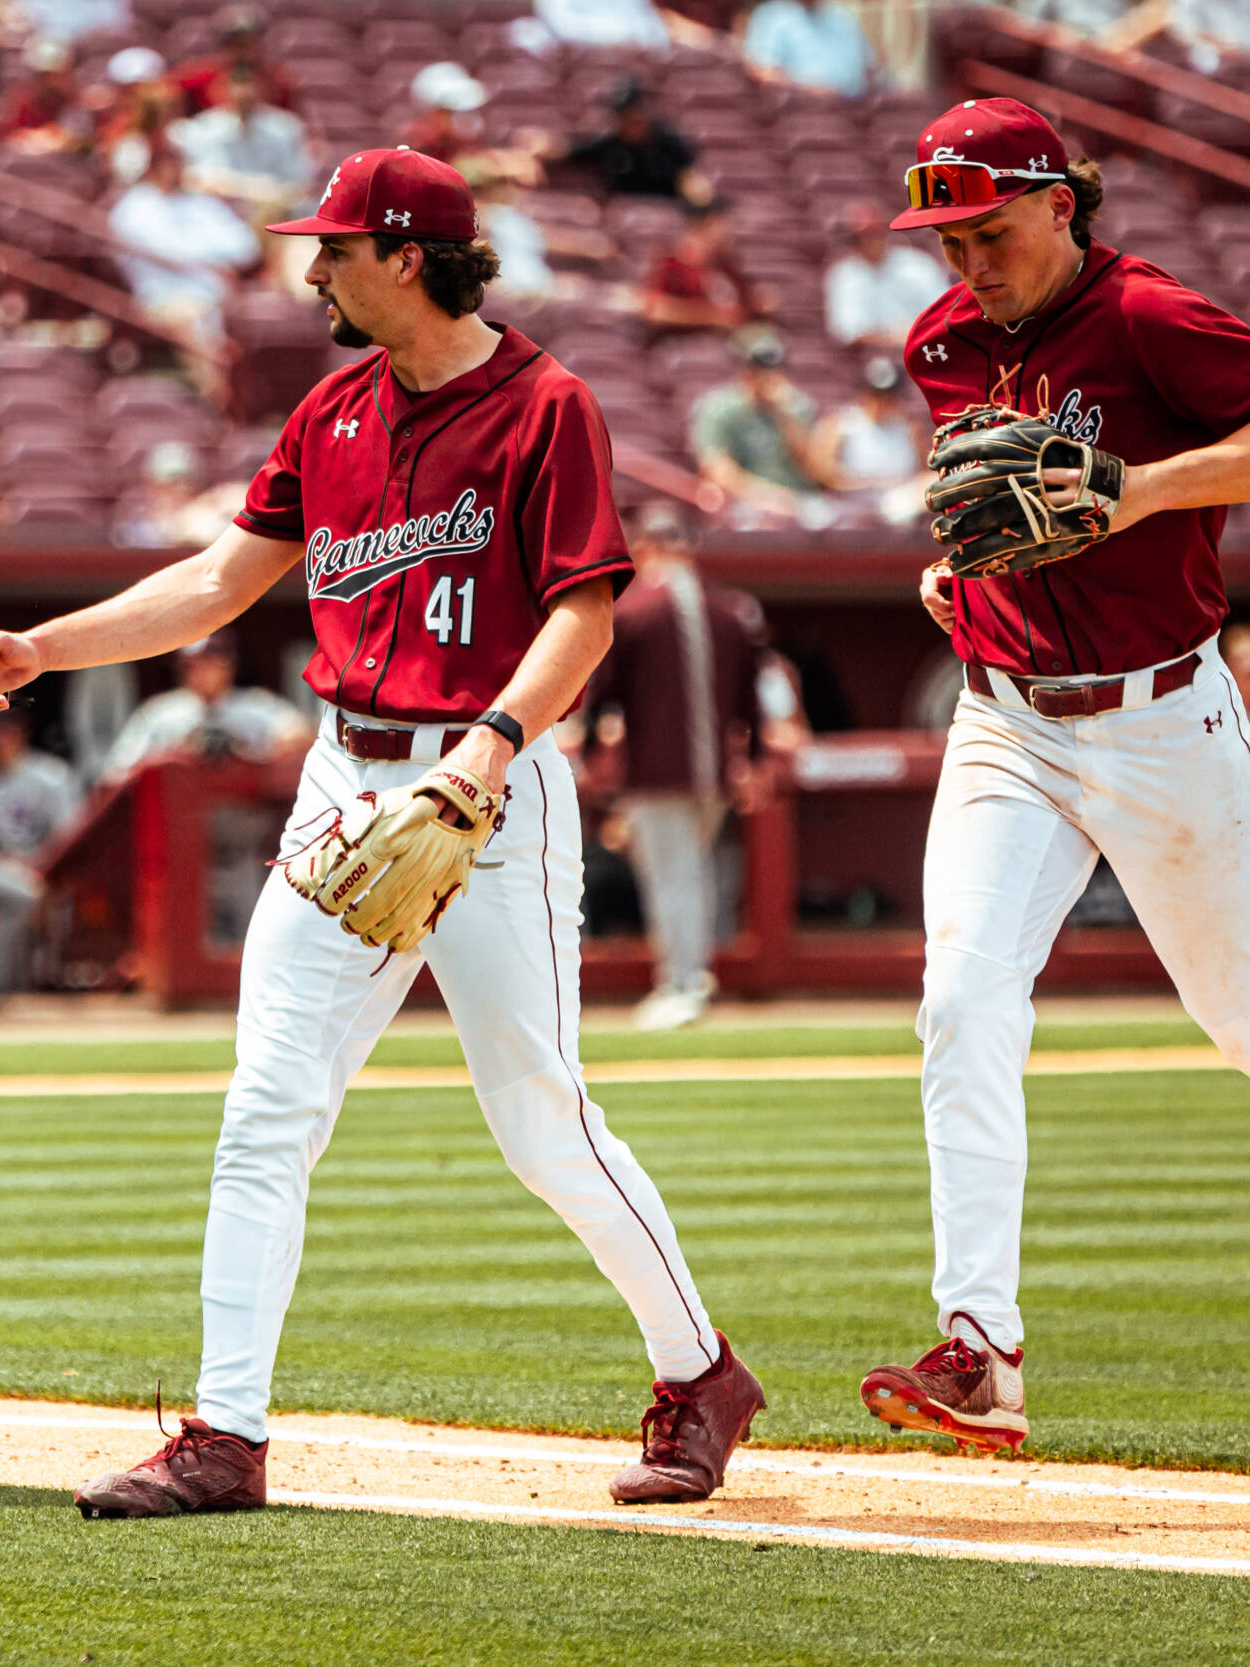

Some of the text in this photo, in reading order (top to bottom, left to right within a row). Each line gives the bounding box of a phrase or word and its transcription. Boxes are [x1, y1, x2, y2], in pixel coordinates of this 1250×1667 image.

[306, 488, 495, 600] Gamecocks
[423, 573, 478, 647] 41
[332, 861, 369, 904] A2000
